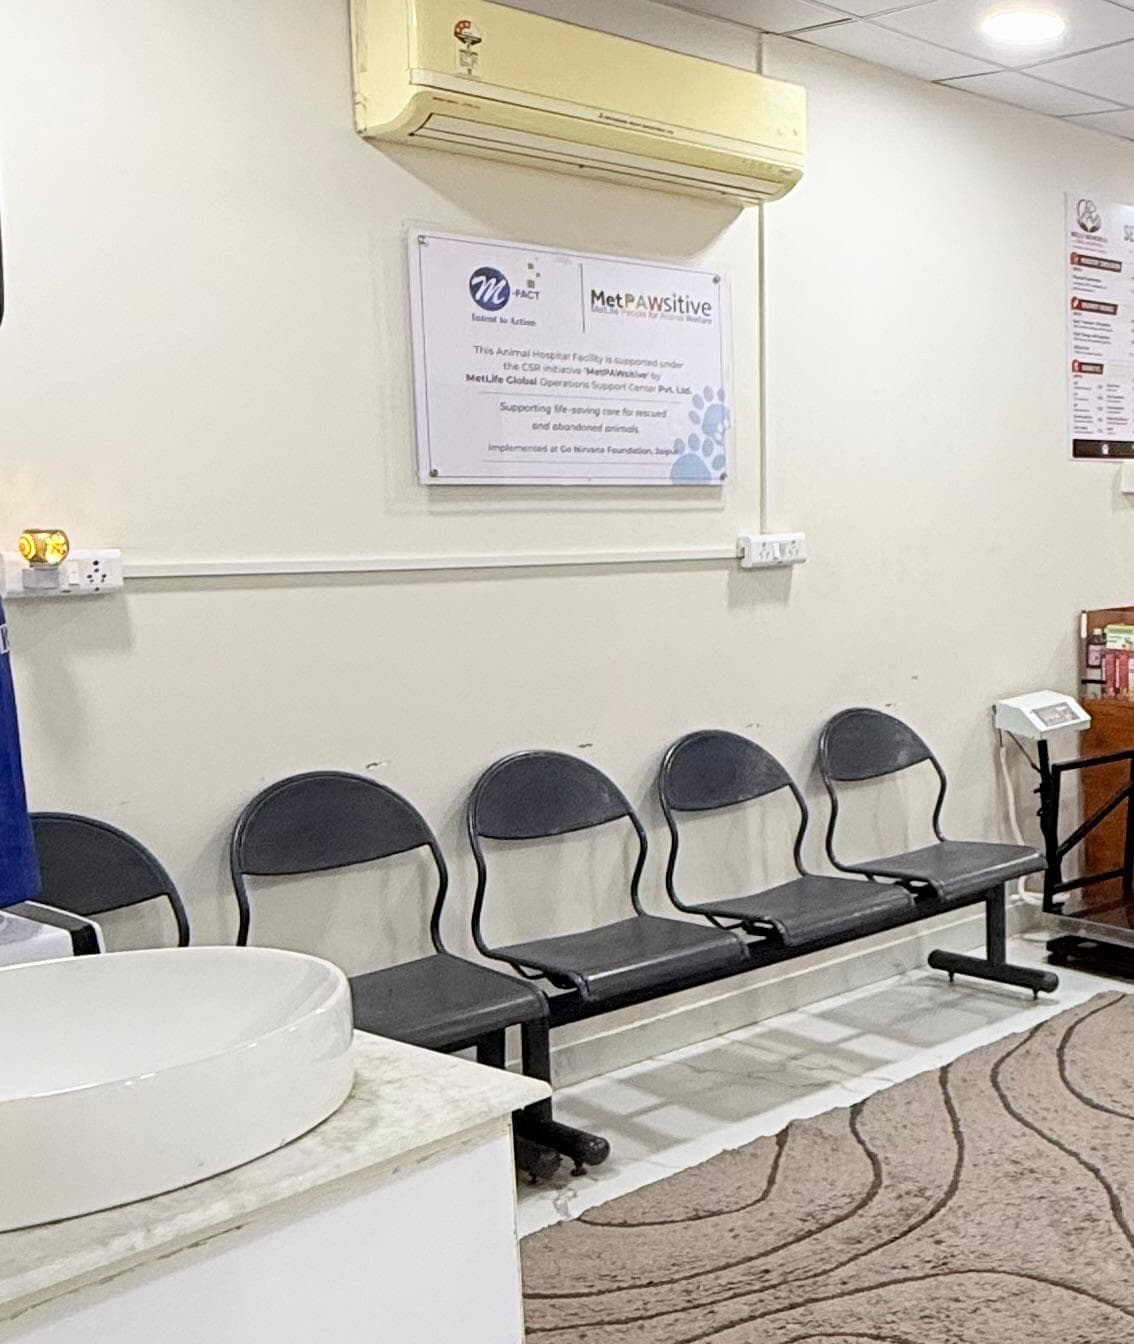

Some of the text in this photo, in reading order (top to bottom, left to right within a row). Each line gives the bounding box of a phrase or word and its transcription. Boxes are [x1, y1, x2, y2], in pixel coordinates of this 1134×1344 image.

[590, 289, 712, 317] MetPAWsitive
[472, 312, 536, 327] Intent to Action
[473, 345, 684, 369] This Animal Hospital Facility is supported under
[503, 362, 520, 371] the
[521, 363, 541, 372] CSR
[651, 371, 661, 382] by
[466, 374, 503, 384] MetLife
[506, 376, 537, 386] Global
[540, 377, 590, 389] Operations
[591, 380, 626, 392] Support
[499, 401, 667, 419] Supporting life-saving care for rescued
[532, 422, 550, 431] and
[552, 422, 603, 433] abandoned
[550, 445, 559, 453] at
[574, 445, 606, 454] Nirvana
